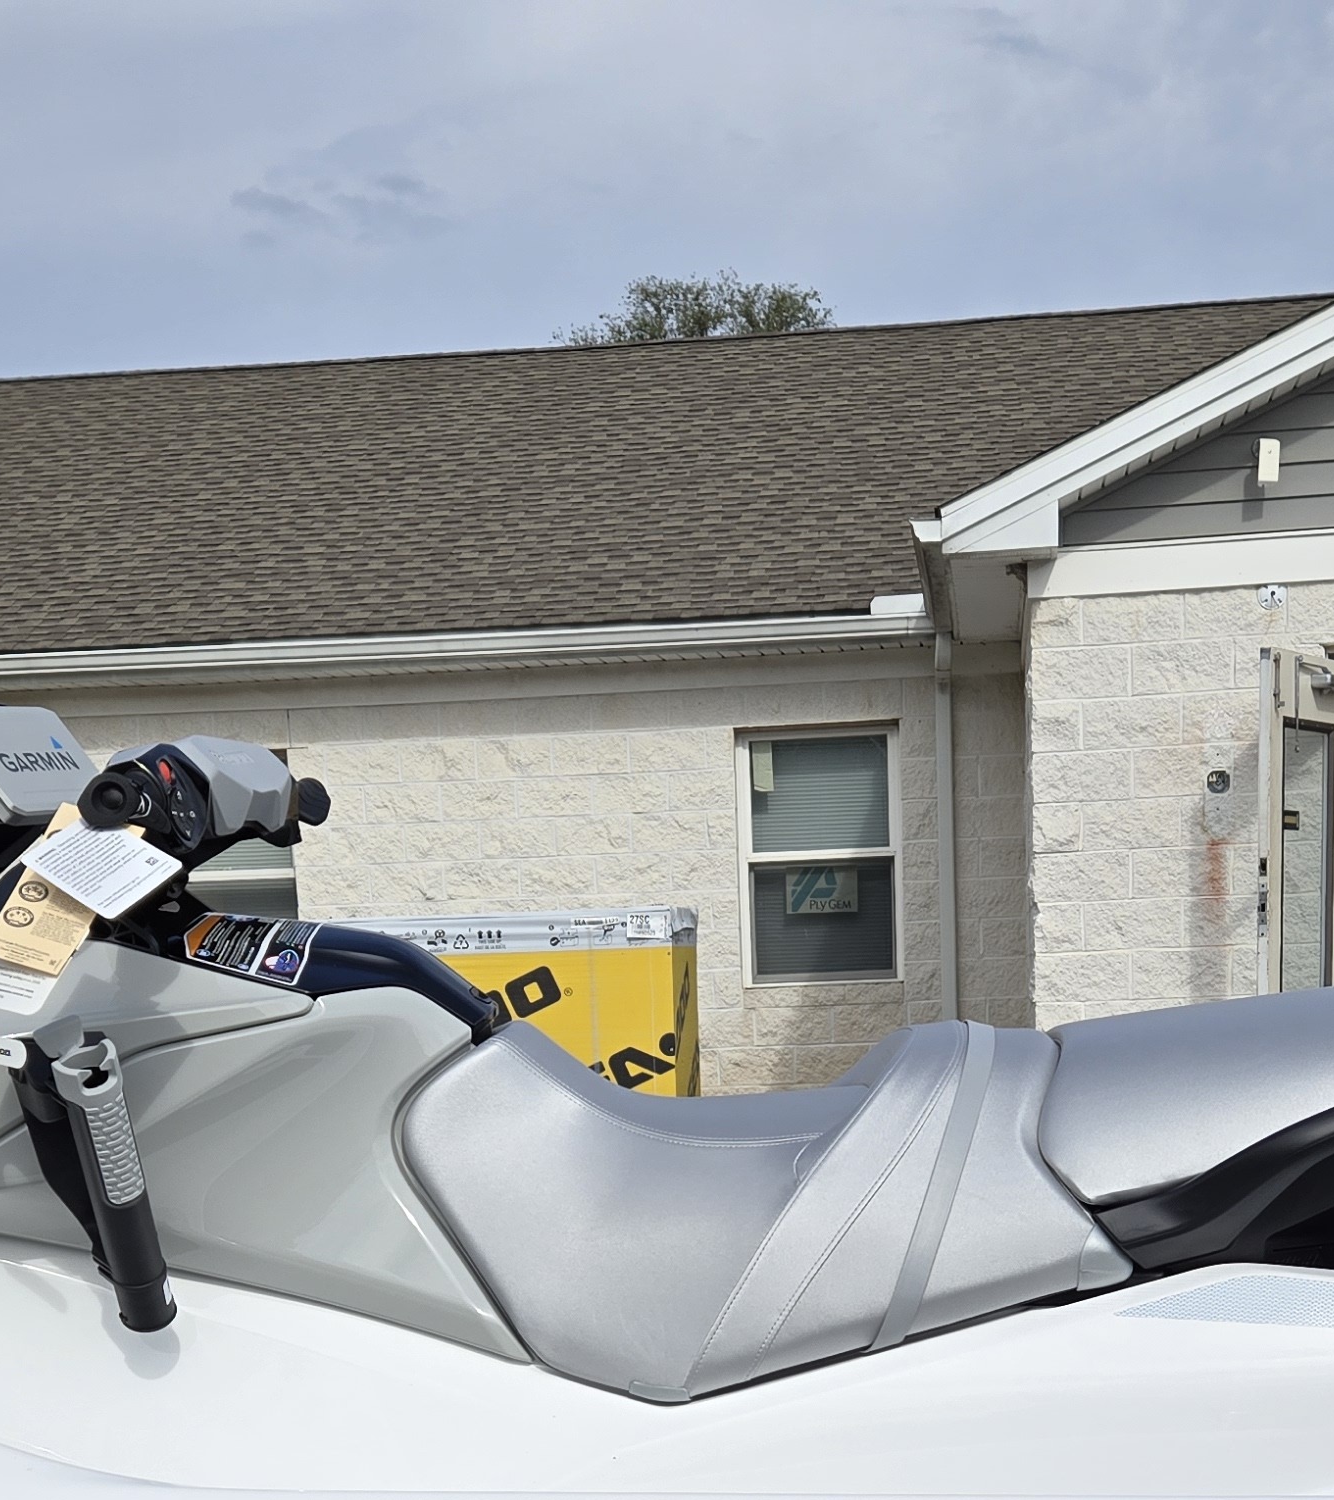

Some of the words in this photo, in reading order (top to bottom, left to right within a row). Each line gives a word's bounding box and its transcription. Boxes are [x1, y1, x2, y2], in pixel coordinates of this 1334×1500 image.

[0, 751, 80, 773] GARMIN
[828, 899, 852, 910] GEM
[629, 915, 650, 925] 27SC
